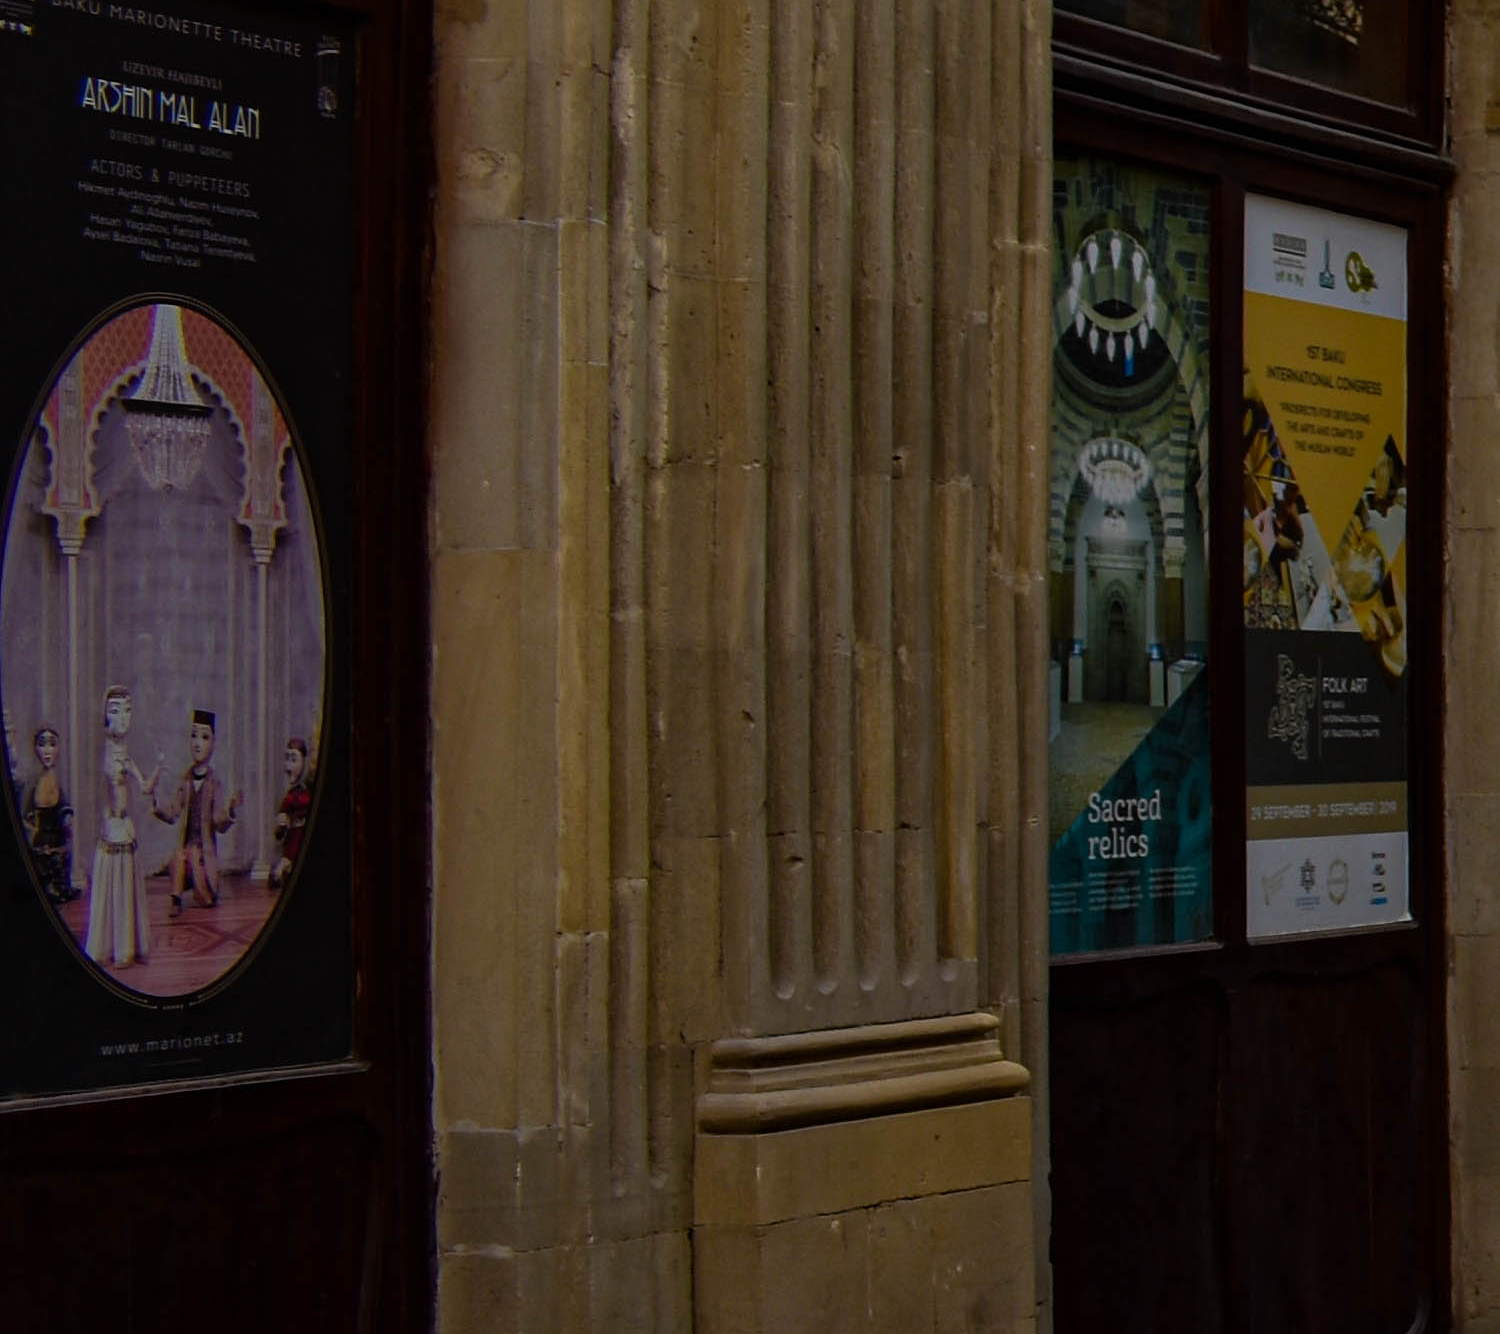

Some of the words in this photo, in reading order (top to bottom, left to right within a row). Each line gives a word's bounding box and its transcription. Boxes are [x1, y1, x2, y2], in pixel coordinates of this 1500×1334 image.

[109, 3, 224, 42] MARIONETTE
[230, 28, 304, 58] THEATRE
[81, 75, 154, 121] ARSHIN
[159, 89, 202, 130] MAL
[207, 99, 261, 140] ALAN
[90, 157, 144, 181] ACTORS
[150, 166, 161, 184] &
[167, 170, 251, 198] PUPPETEERS
[1266, 365, 1334, 390] INTERNATIONAL
[1336, 375, 1383, 396] CONGRESS
[1322, 676, 1348, 694] FOLK
[1350, 676, 1369, 694] ART
[1087, 788, 1162, 824] Sacred
[1263, 803, 1311, 820] SEPTEMBER
[1330, 800, 1375, 817] SEPTEMBER
[1087, 826, 1149, 860] relics
[99, 1029, 245, 1057] www.marionet.az
